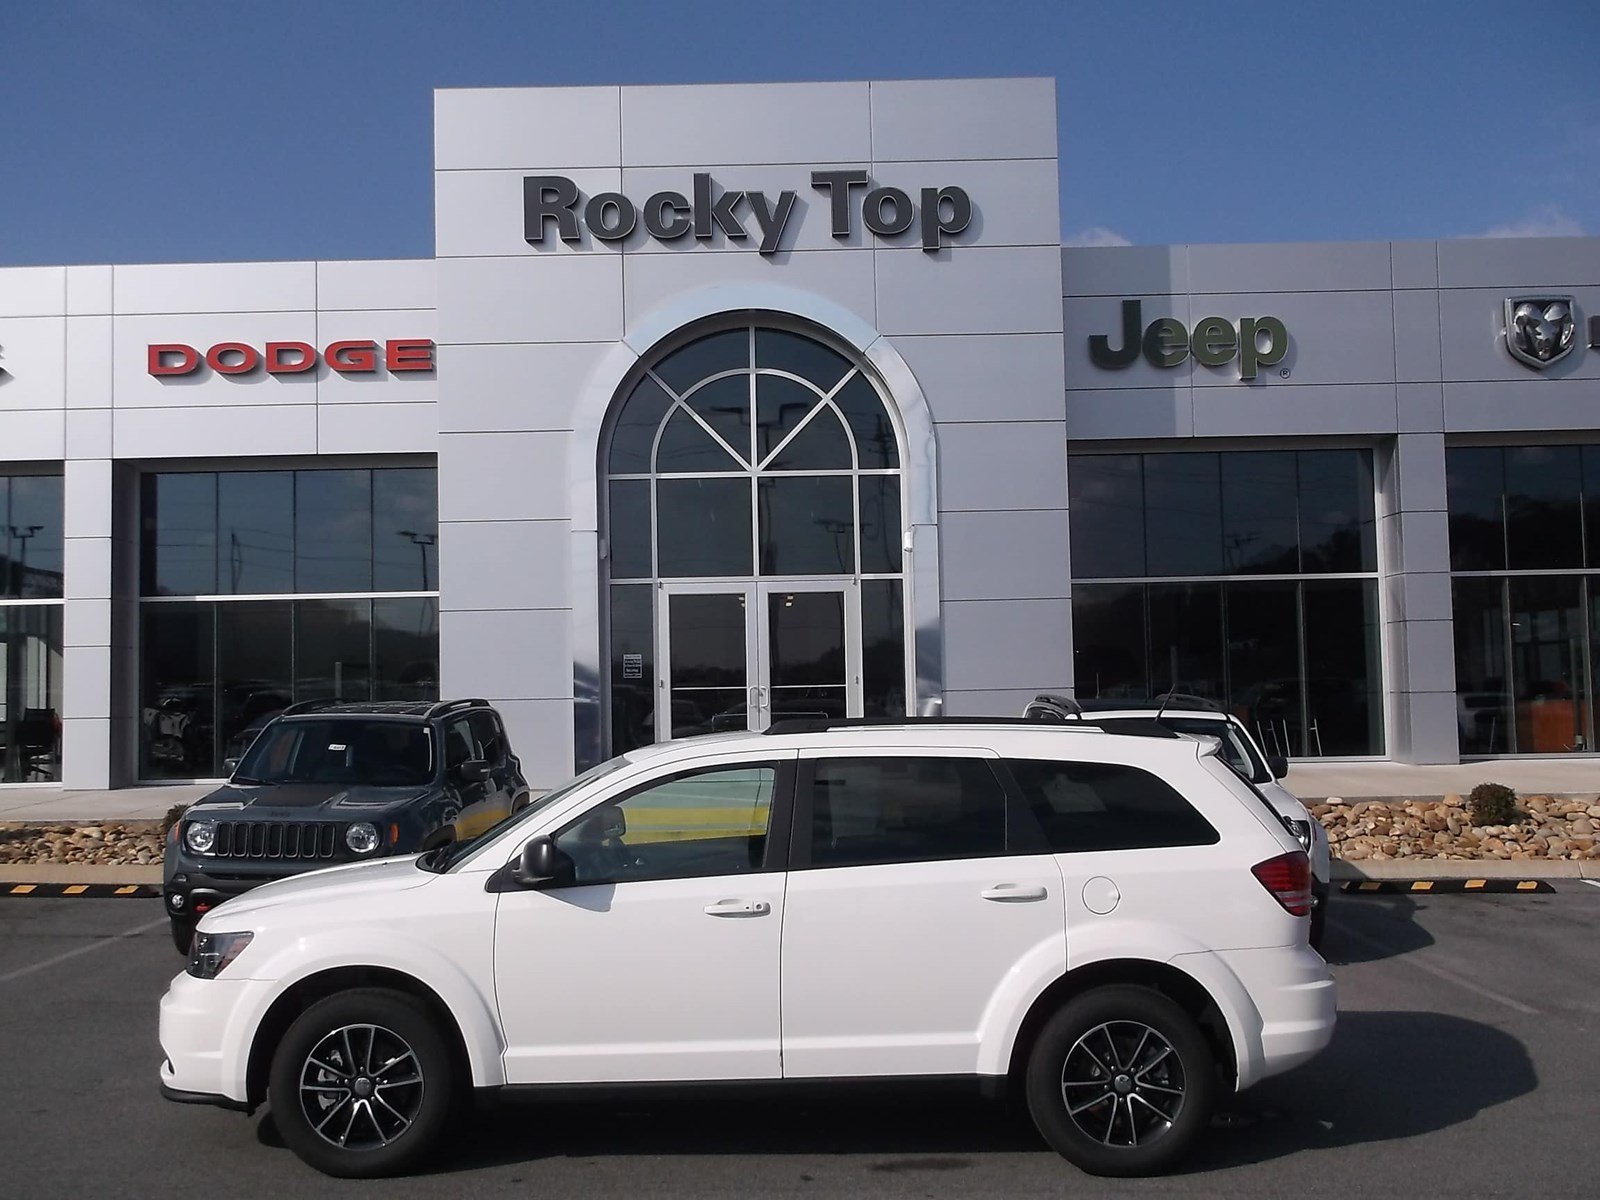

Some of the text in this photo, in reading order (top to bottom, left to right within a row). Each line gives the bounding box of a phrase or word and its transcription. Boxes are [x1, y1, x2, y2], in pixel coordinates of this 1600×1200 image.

[523, 169, 973, 255] Rocky Top
[147, 338, 436, 376] DODGE
[1088, 299, 1290, 381] Jeep
